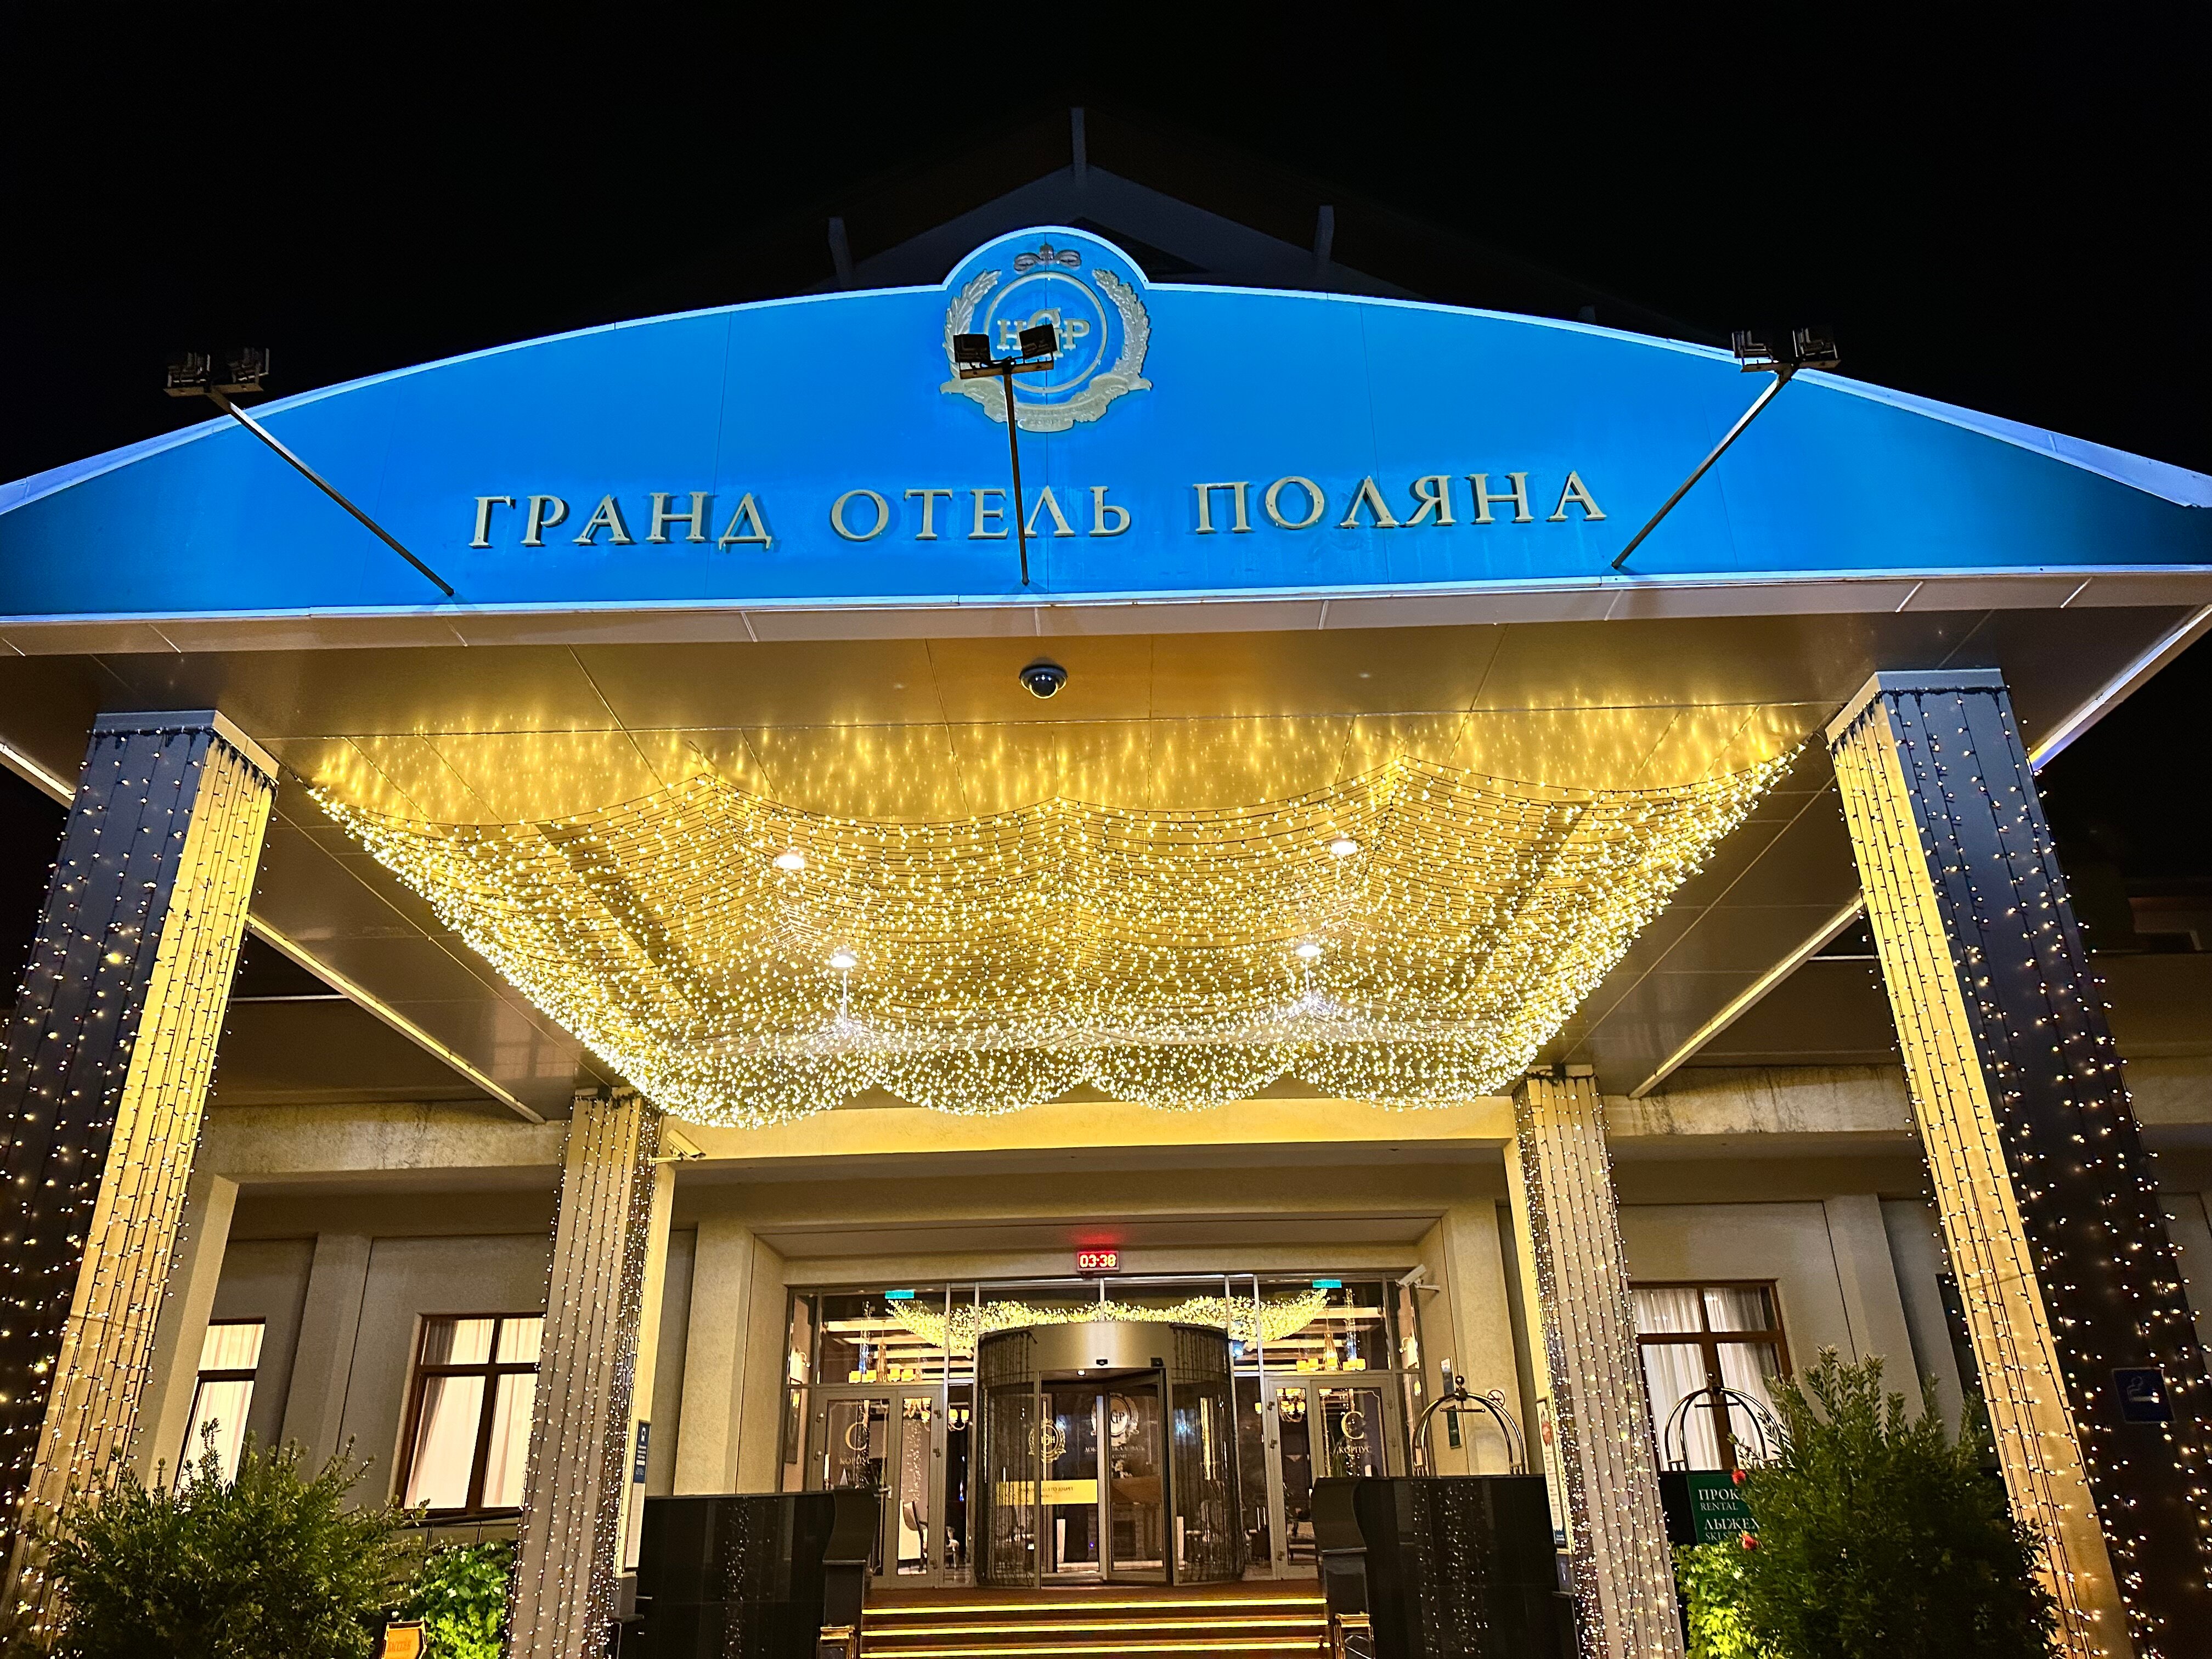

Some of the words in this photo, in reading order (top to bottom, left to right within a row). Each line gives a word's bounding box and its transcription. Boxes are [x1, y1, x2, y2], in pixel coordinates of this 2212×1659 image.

[468, 492, 772, 551] ГРАНД
[831, 485, 1130, 542] ОТЕЛЬ
[1192, 470, 1607, 534] ПОЛЯНА
[1339, 1446, 1372, 1454] КОРПУС
[1698, 1488, 1741, 1500] ПРОК
[1700, 1502, 1739, 1511] RENTAL
